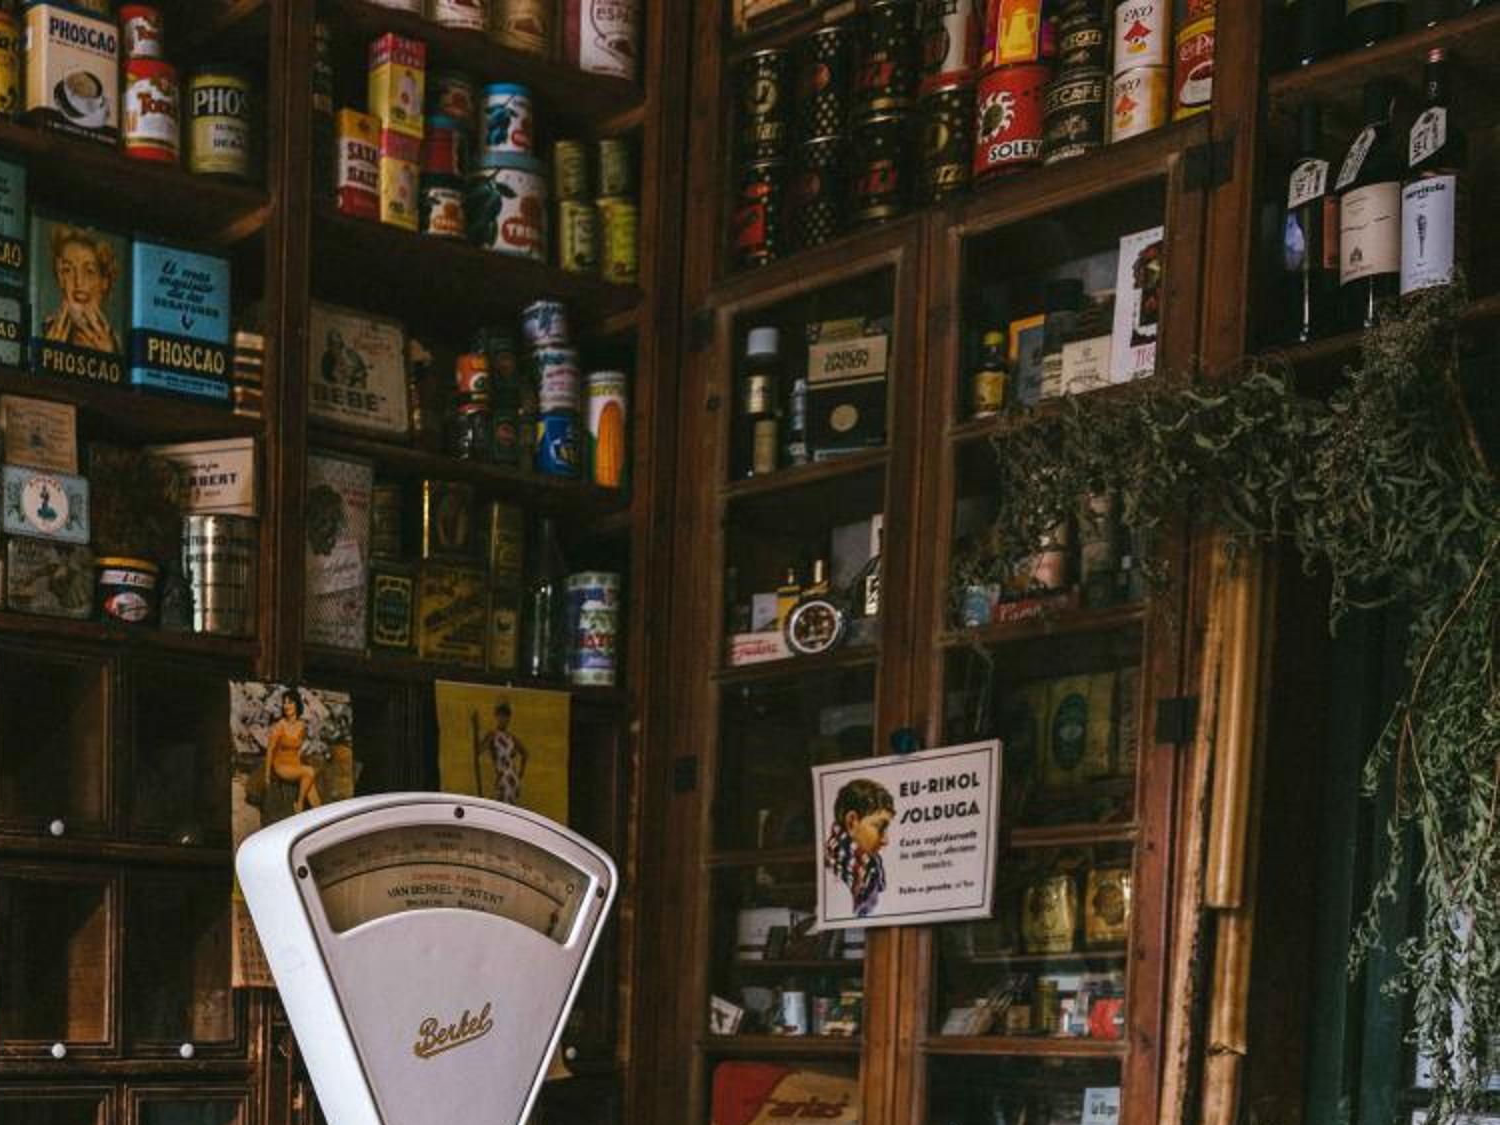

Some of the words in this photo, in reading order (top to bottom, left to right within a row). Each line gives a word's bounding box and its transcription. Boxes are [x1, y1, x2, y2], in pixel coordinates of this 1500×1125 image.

[50, 16, 117, 54] PHOSCAO
[42, 349, 121, 384] PHOSCAO
[148, 337, 225, 375] PHOSCAO
[899, 772, 981, 798] EU-RINOL
[900, 800, 981, 825] SOLDUGA
[388, 884, 409, 898] VAN
[462, 888, 504, 905] PATENT
[414, 1002, 493, 1057] Berkel
